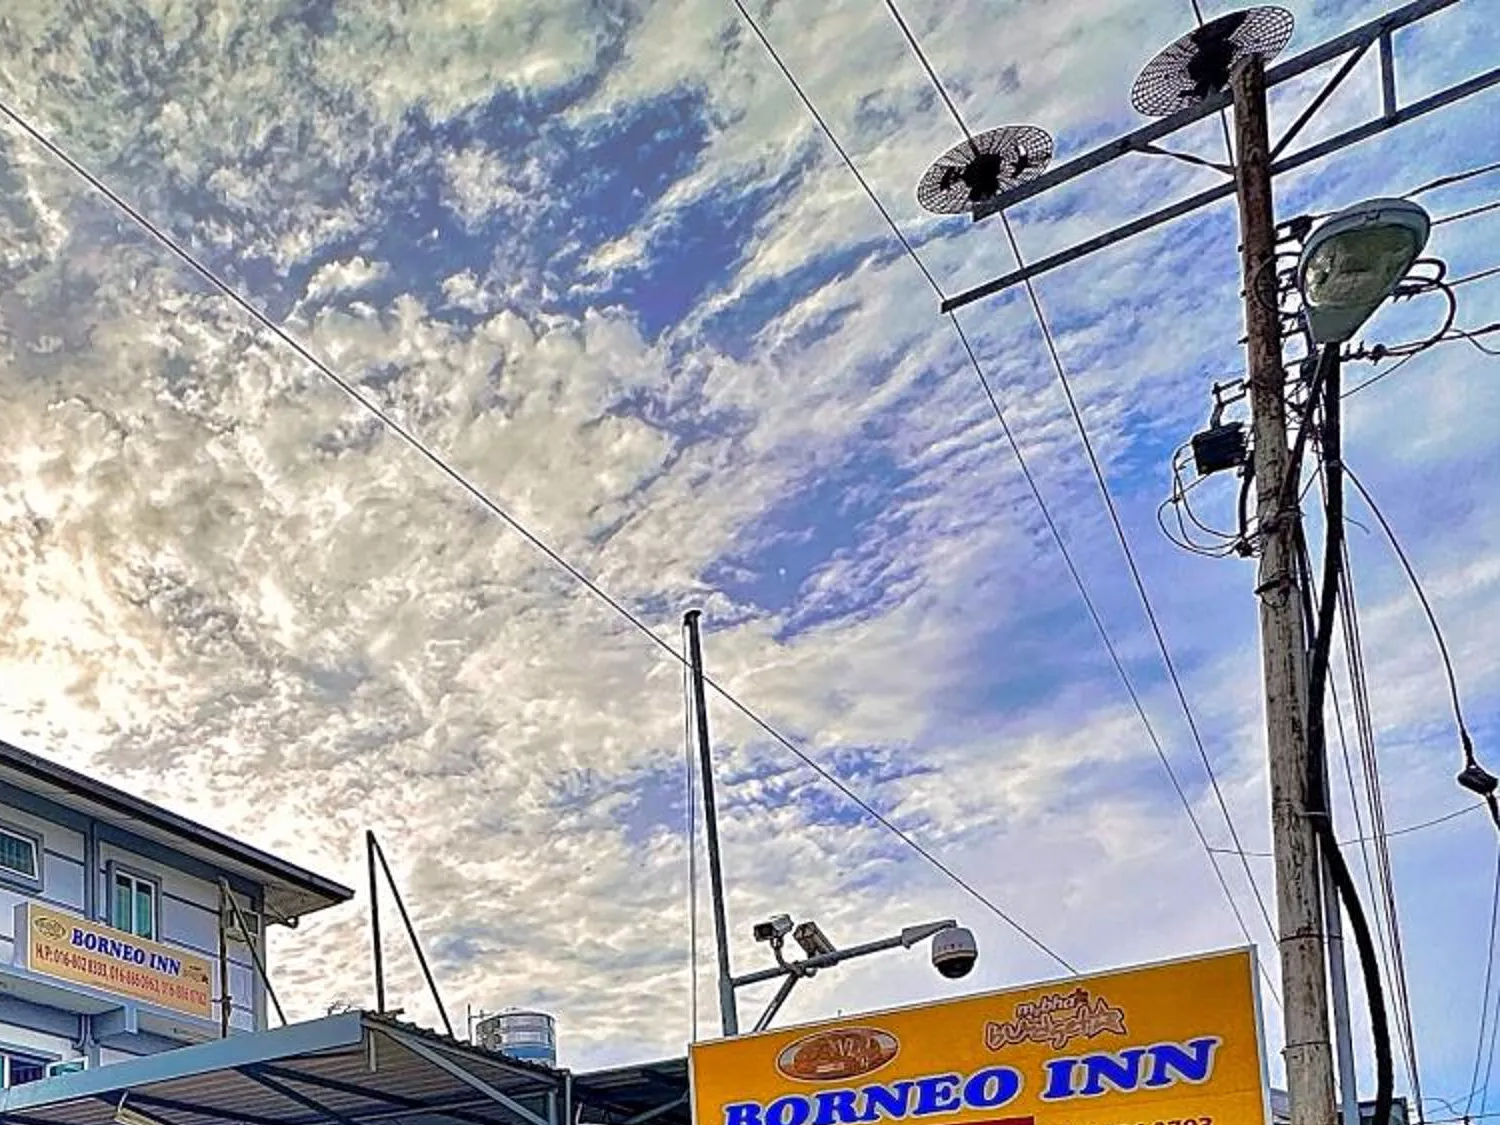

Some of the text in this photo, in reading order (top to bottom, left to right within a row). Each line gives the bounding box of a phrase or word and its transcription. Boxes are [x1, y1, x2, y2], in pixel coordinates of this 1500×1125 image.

[71, 927, 146, 965] BORNEO
[149, 953, 181, 976] INN
[1043, 1038, 1217, 1099] INN
